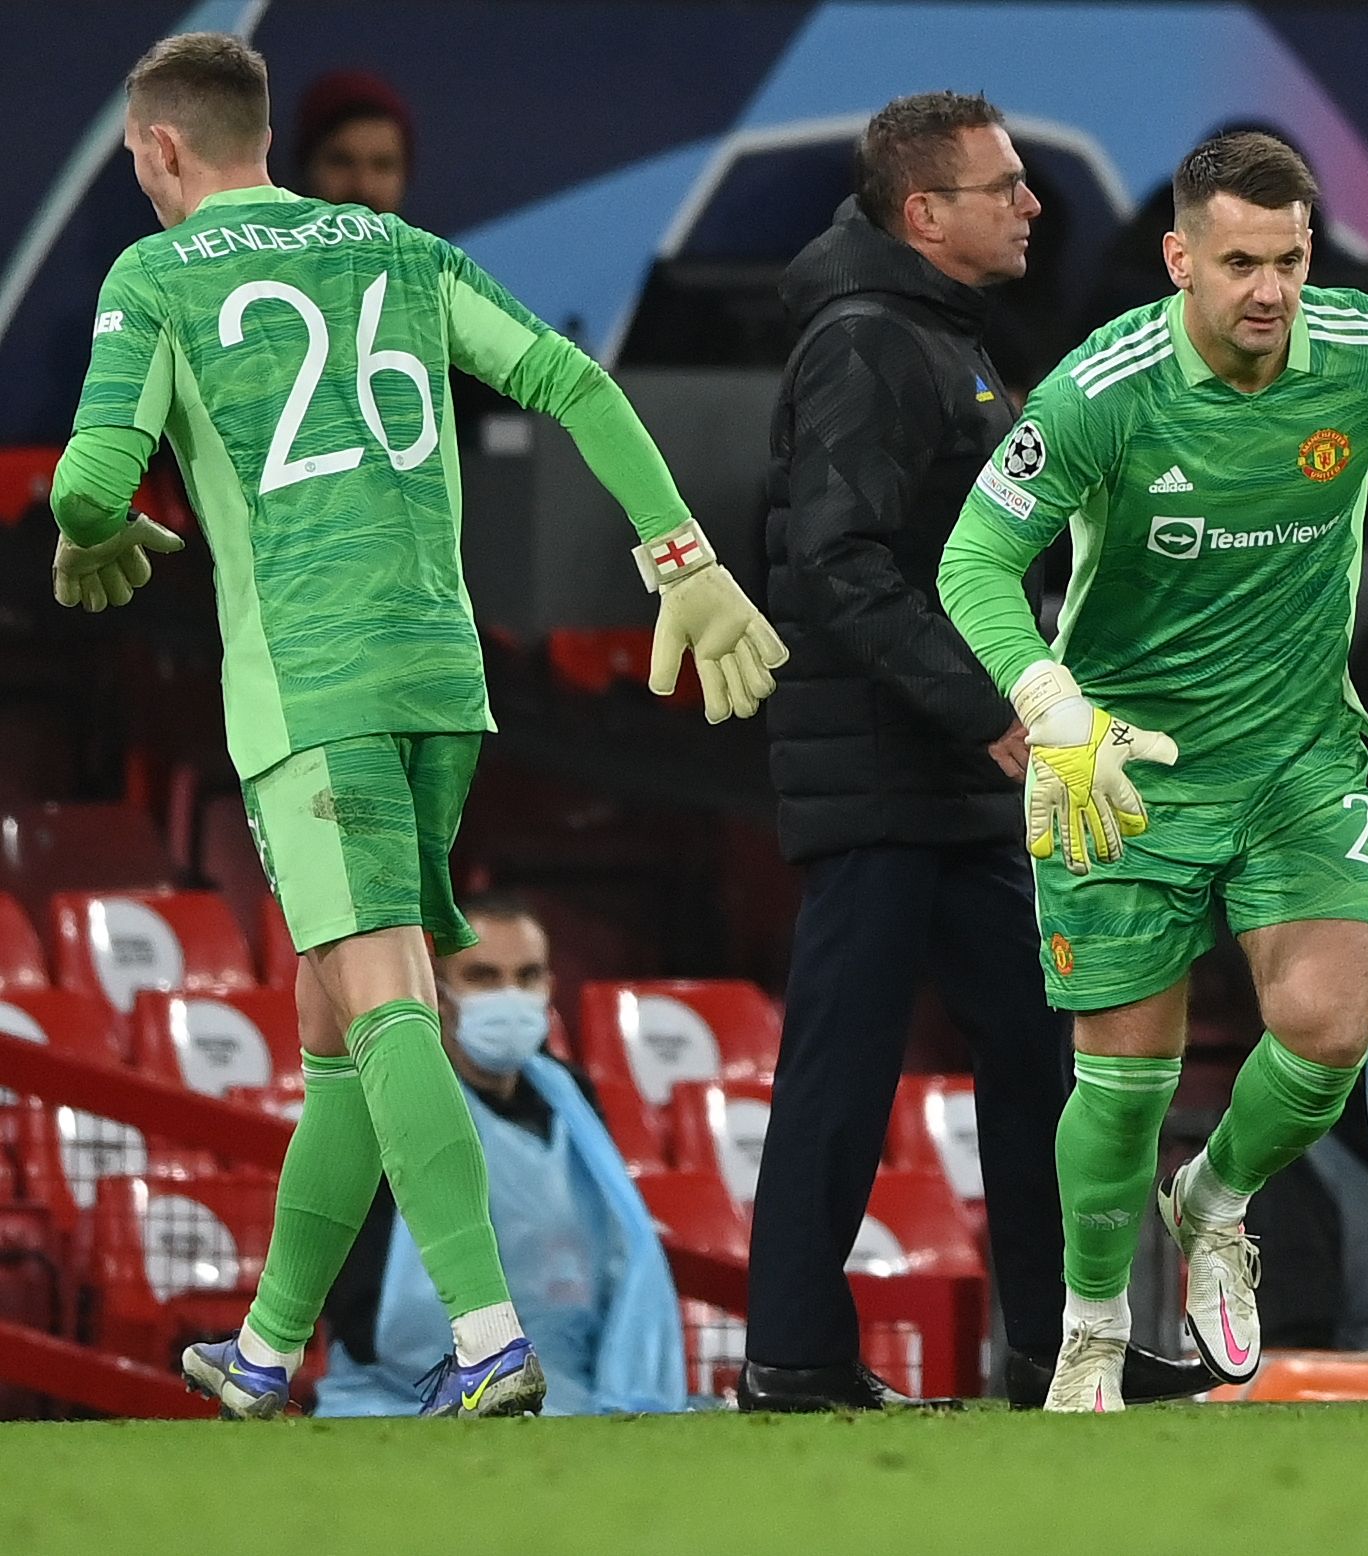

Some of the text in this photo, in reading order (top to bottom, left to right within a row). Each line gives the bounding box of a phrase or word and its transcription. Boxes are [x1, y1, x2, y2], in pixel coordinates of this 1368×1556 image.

[172, 214, 390, 264] HENDERSON
[218, 270, 439, 494] 26
[1149, 482, 1194, 494] adidas
